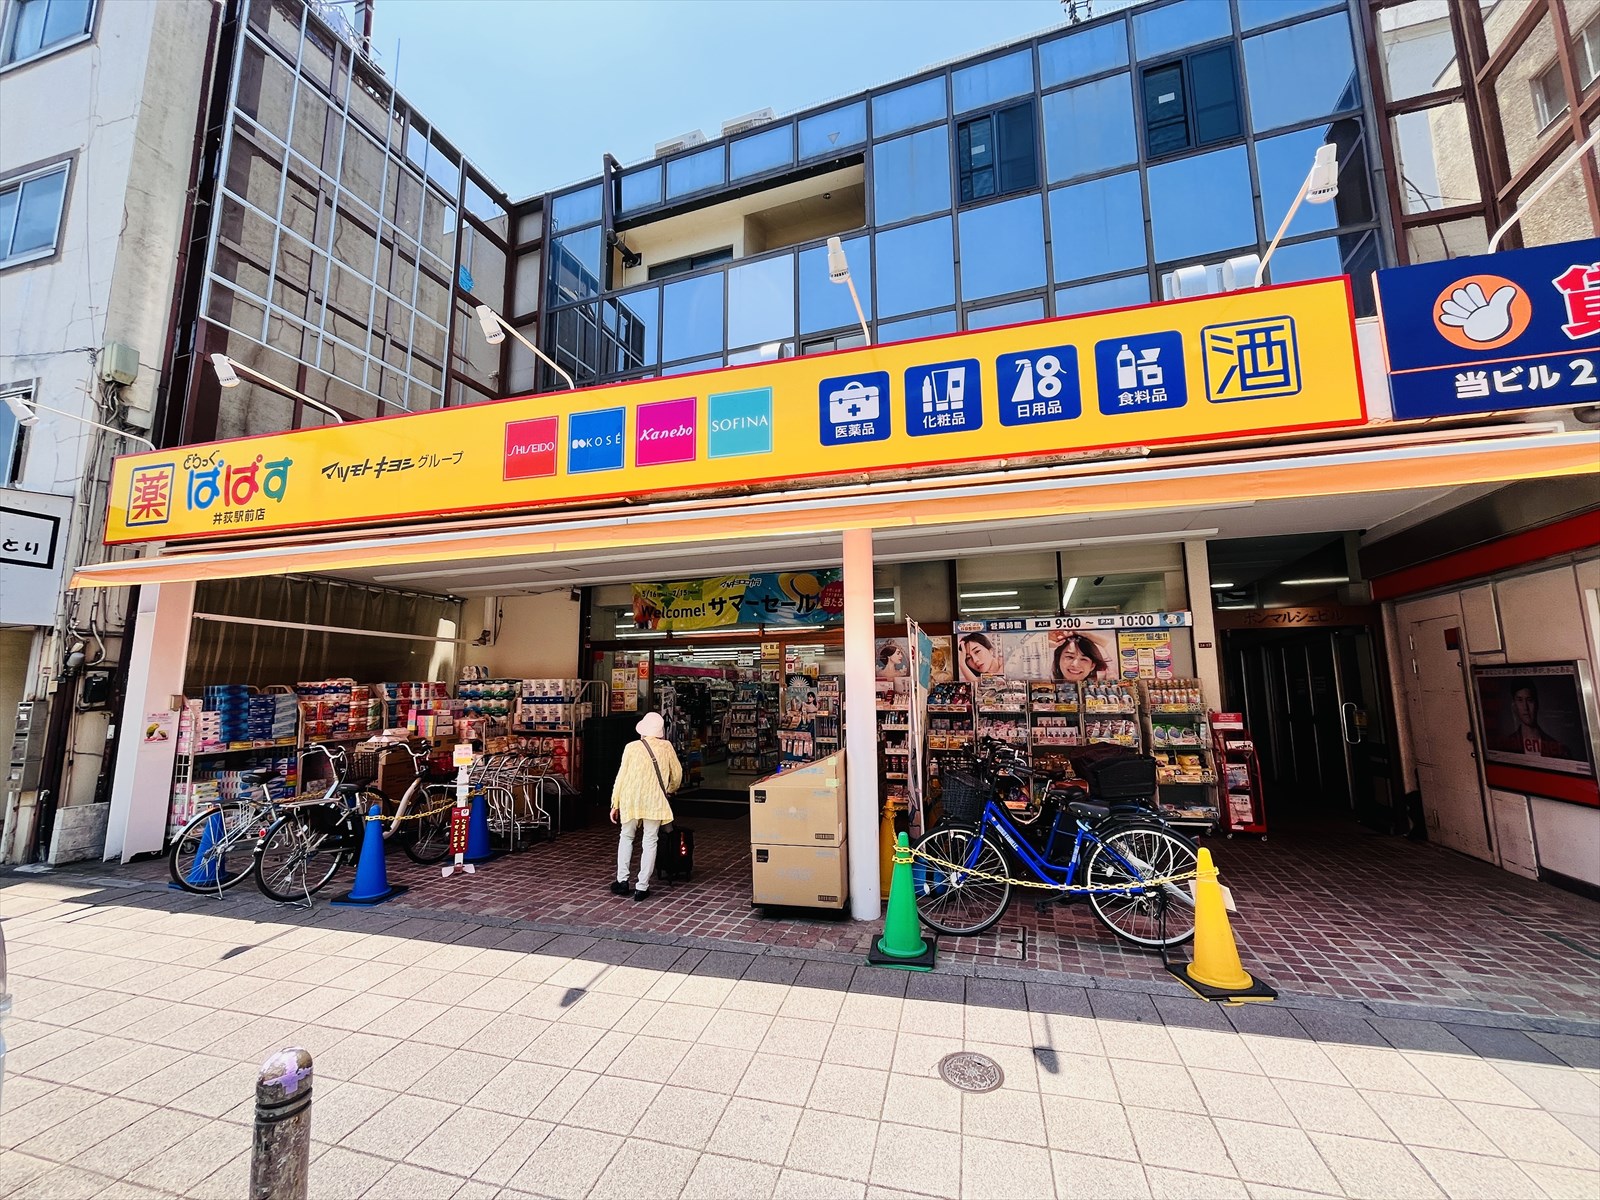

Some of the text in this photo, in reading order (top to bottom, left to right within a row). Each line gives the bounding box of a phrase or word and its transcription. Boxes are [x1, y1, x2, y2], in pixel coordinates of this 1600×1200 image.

[1210, 324, 1289, 394] 酒
[1117, 387, 1168, 407] 食料品
[1017, 400, 1063, 418] 日用品
[711, 414, 768, 433] SOFINA
[922, 410, 966, 429] 化粧品
[639, 424, 693, 442] Kanebo
[834, 422, 876, 440] 医薬品
[507, 440, 555, 457] SHISEIDO
[586, 432, 622, 449] KOSÉ
[183, 450, 221, 470] どらっぐ
[186, 454, 294, 511] ぱぱす
[132, 468, 170, 521] 薬
[212, 508, 266, 525] 井荻駅前店
[2, 538, 39, 556] とり
[640, 593, 818, 620] Welcome! サマーセール
[1054, 617, 1081, 629] 9:00
[1119, 615, 1154, 627] 10:00
